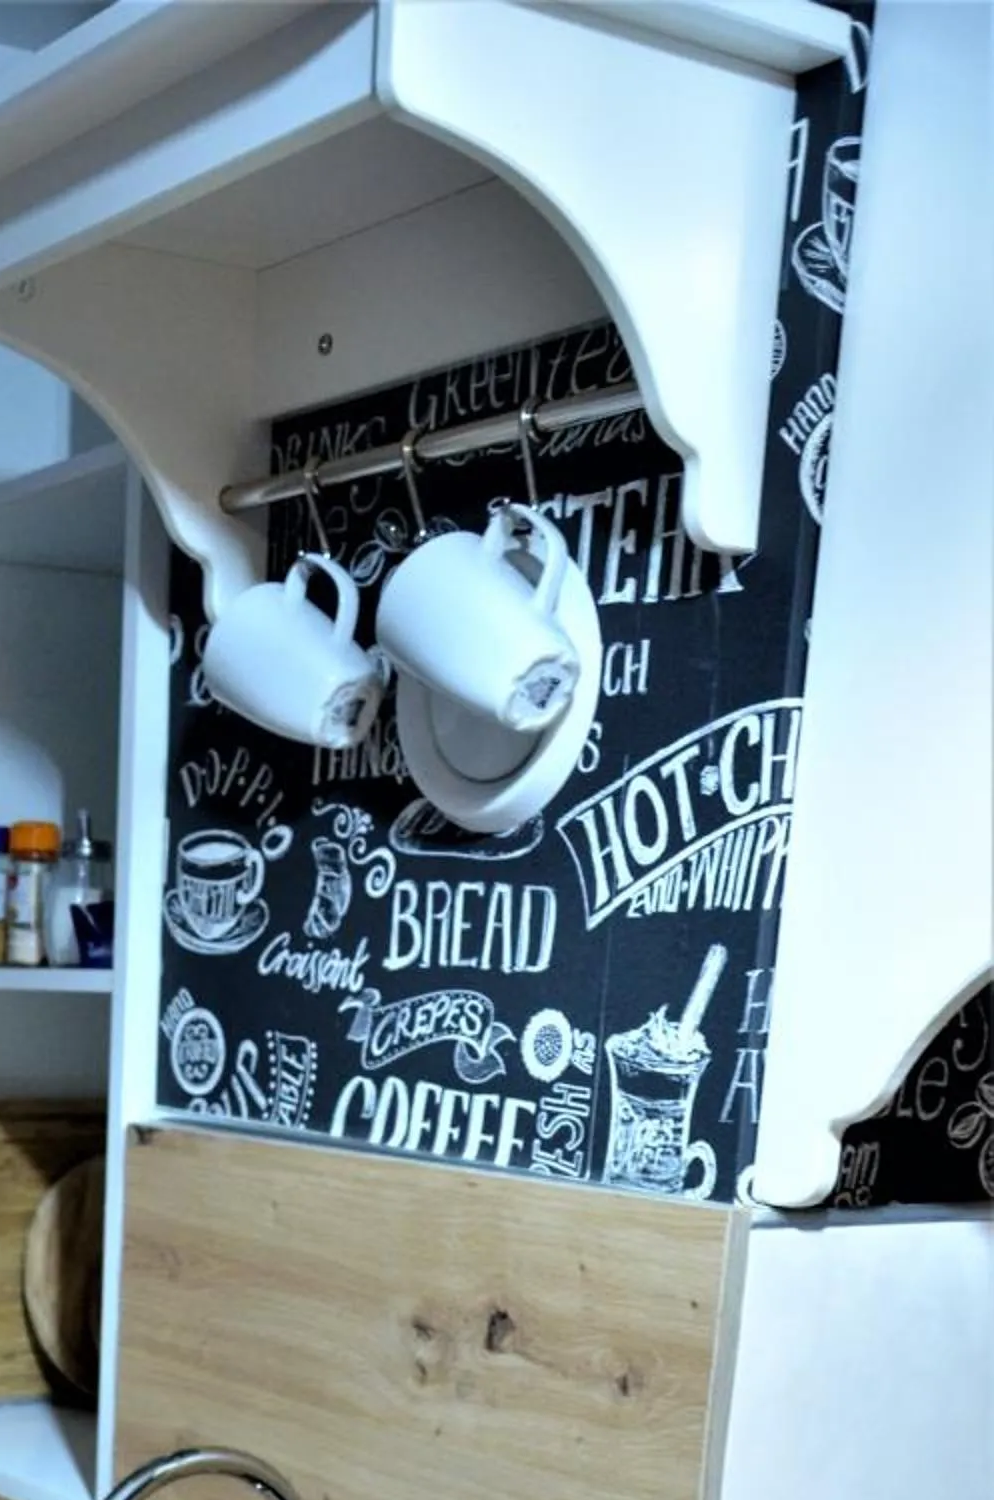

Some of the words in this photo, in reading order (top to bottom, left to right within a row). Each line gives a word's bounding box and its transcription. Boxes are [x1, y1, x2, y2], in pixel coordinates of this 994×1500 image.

[577, 743, 704, 909] HOT
[257, 931, 370, 993] Croissant
[382, 880, 557, 975] BREAD
[369, 996, 484, 1058] CREPES
